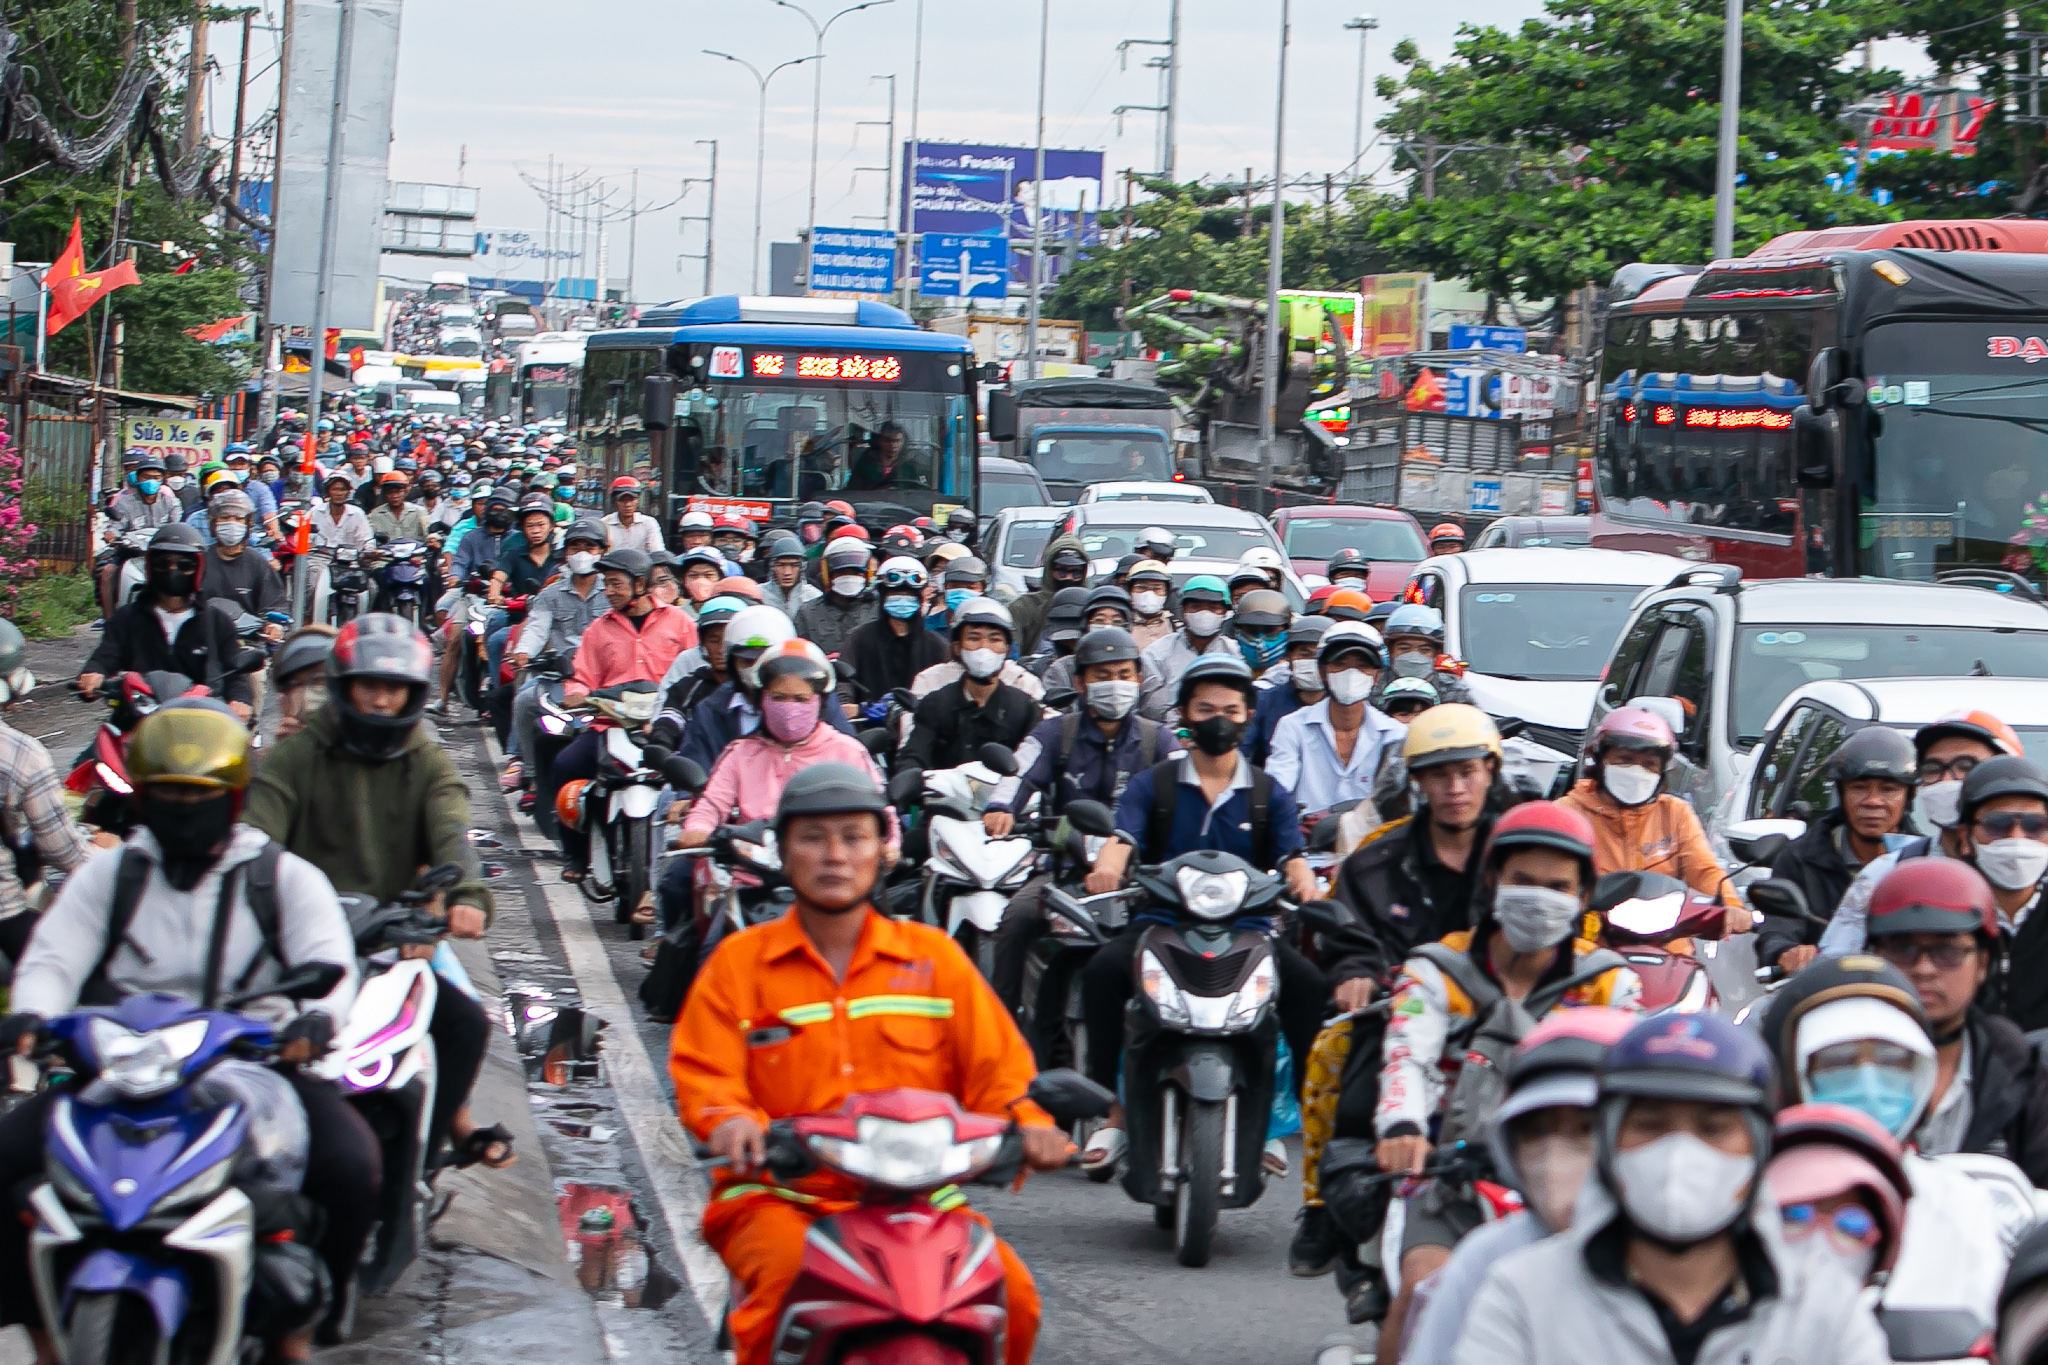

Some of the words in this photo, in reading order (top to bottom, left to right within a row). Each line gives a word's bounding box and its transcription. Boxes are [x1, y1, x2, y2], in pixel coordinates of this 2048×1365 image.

[1987, 336, 2048, 363] ĐẠ
[133, 421, 164, 441] Sửa
[168, 424, 190, 442] Xe
[132, 445, 213, 468] ODA
